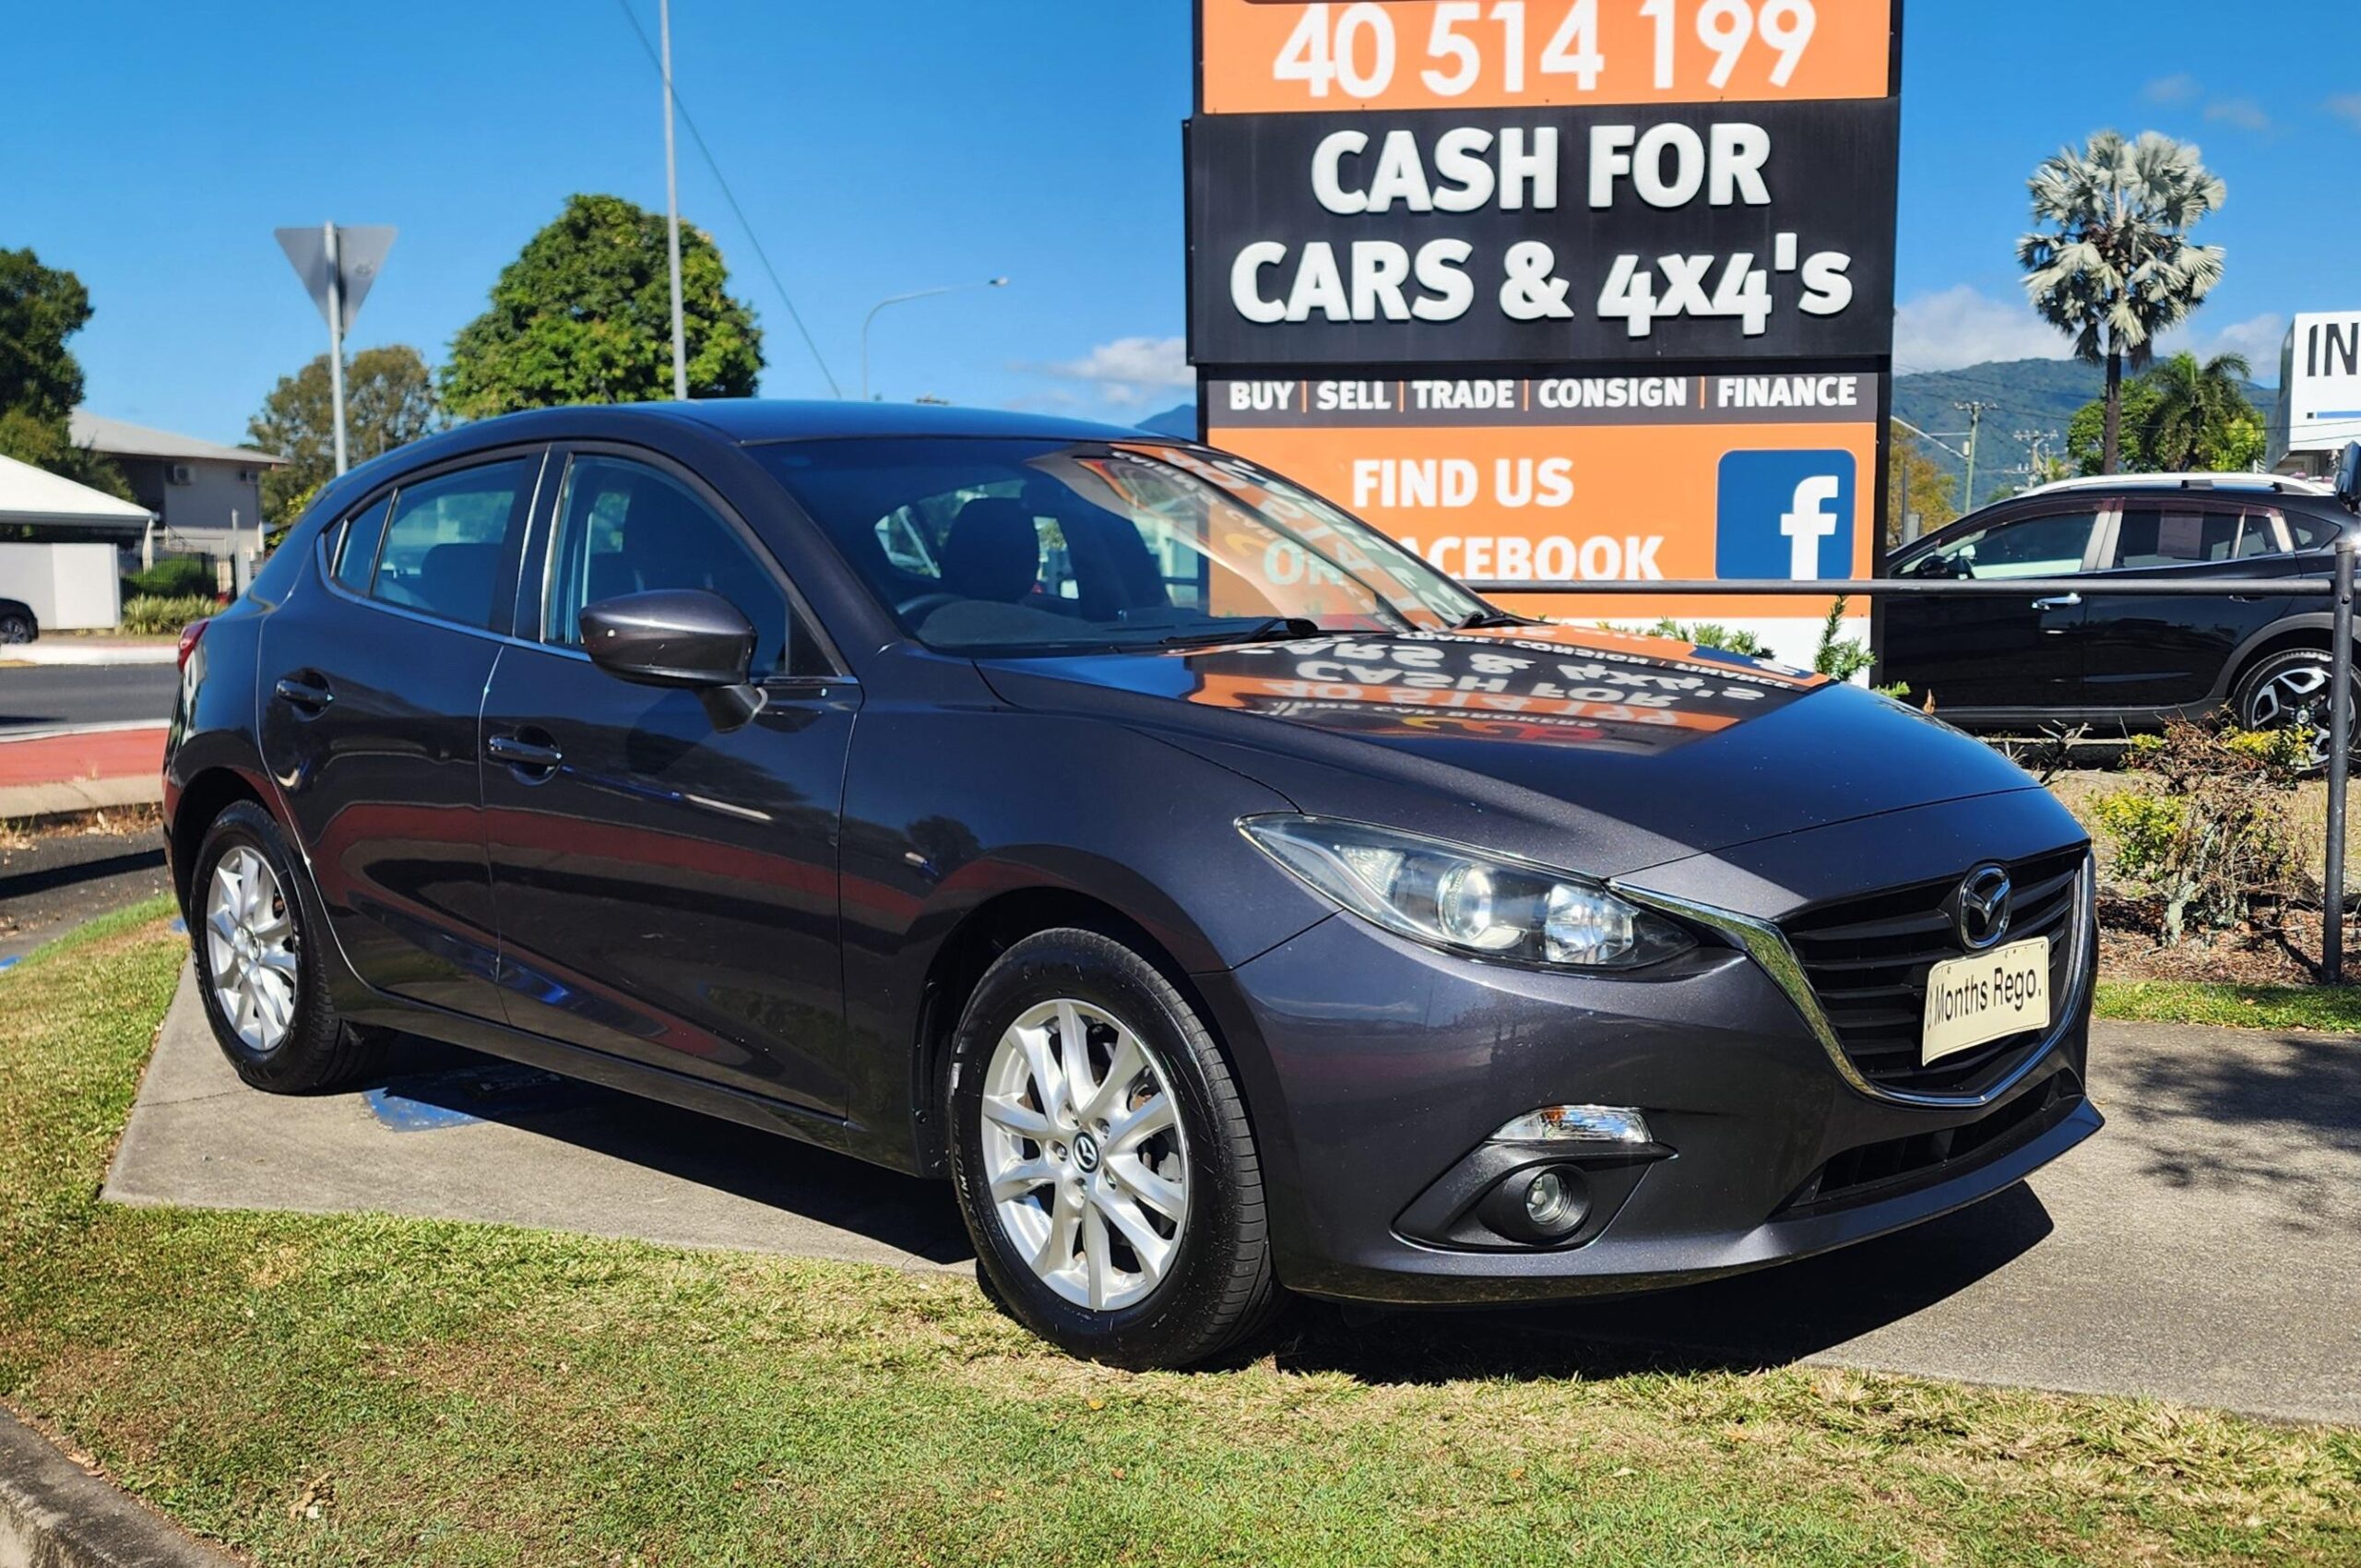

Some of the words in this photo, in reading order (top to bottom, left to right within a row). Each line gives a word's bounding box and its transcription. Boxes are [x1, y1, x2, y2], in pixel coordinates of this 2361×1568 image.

[1273, 1, 1396, 99] 40
[1420, 0, 1605, 97] 514
[1639, 0, 1817, 89] 199
[1311, 125, 1559, 215] CASH
[1588, 122, 1772, 208] FOR
[1229, 238, 1476, 324] CARS
[1498, 240, 1575, 321] &
[2307, 322, 2359, 377] IN
[1229, 380, 1295, 410] BUY
[1315, 380, 1393, 410] SELL
[1411, 379, 1515, 410] TRADE
[1537, 376, 1688, 409] CONSIGN
[1717, 375, 1858, 408] FINANCE
[1352, 458, 1479, 508] FIND
[1494, 457, 1575, 507] US
[1935, 974, 1988, 1026] Months
[1993, 967, 2042, 1011] Rego.
